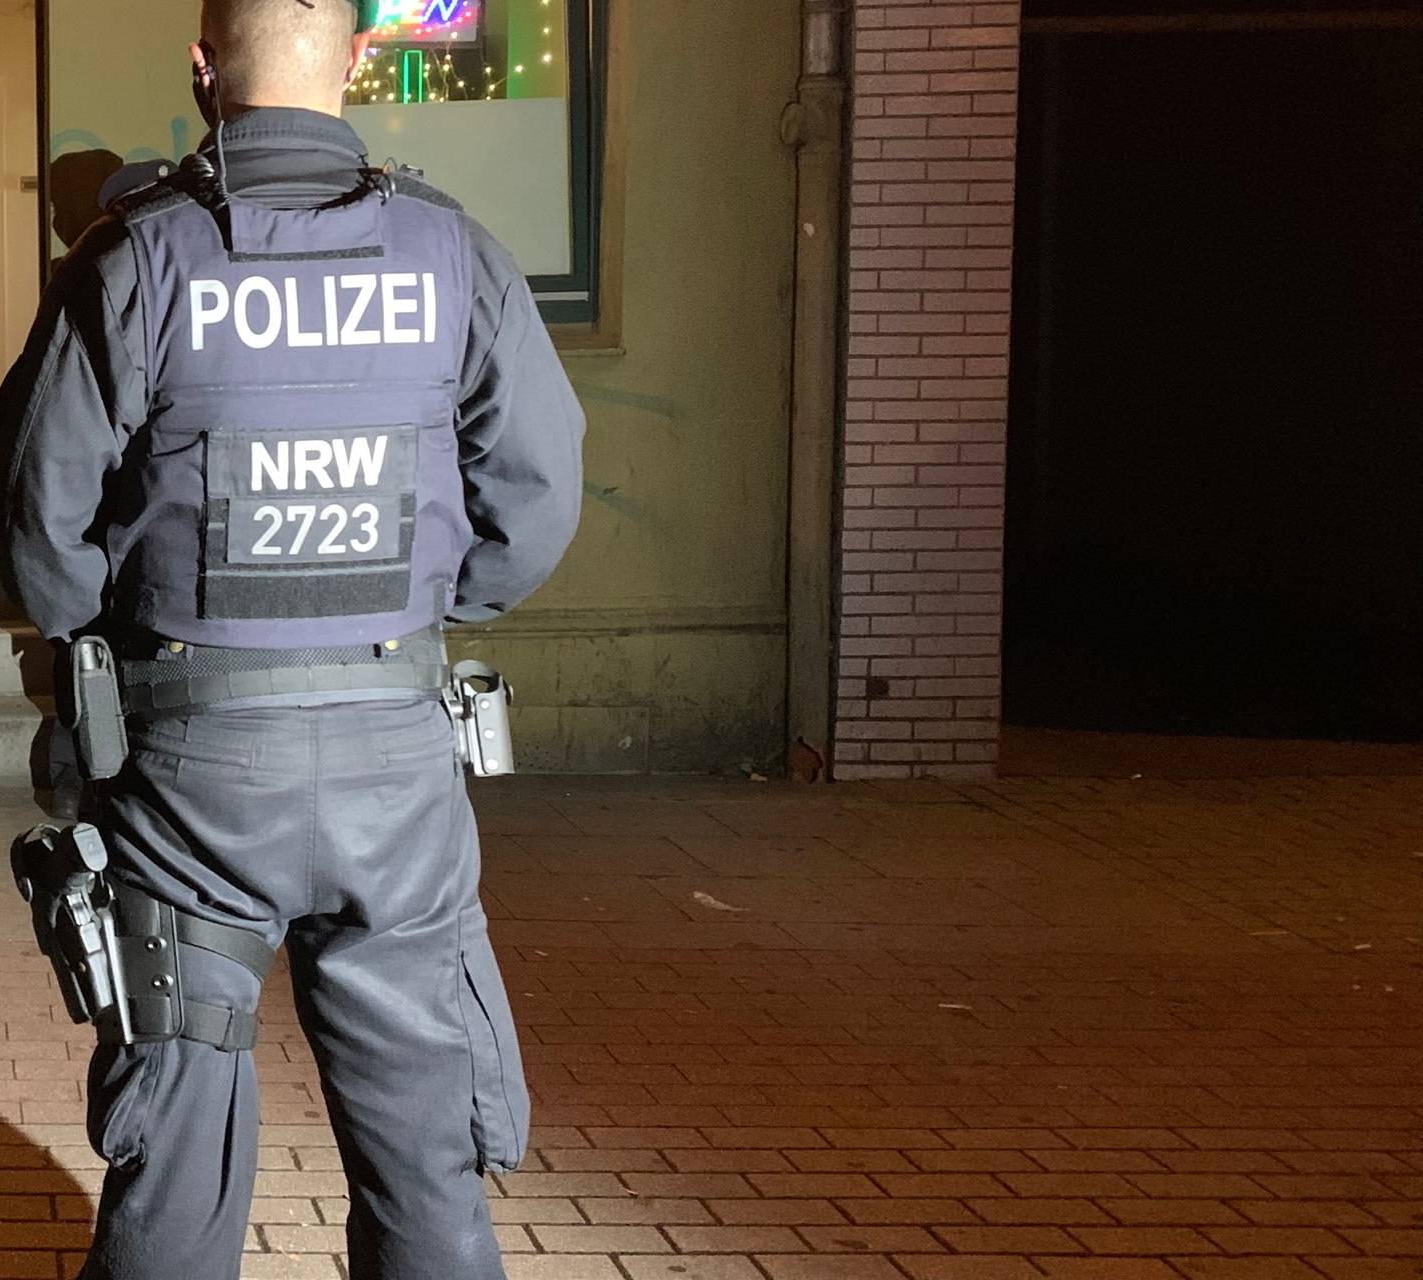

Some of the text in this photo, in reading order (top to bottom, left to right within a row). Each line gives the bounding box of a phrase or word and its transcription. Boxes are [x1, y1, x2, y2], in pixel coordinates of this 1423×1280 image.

[189, 272, 437, 351] POLIZEI
[250, 435, 388, 491] NRW
[251, 502, 380, 556] 2723
